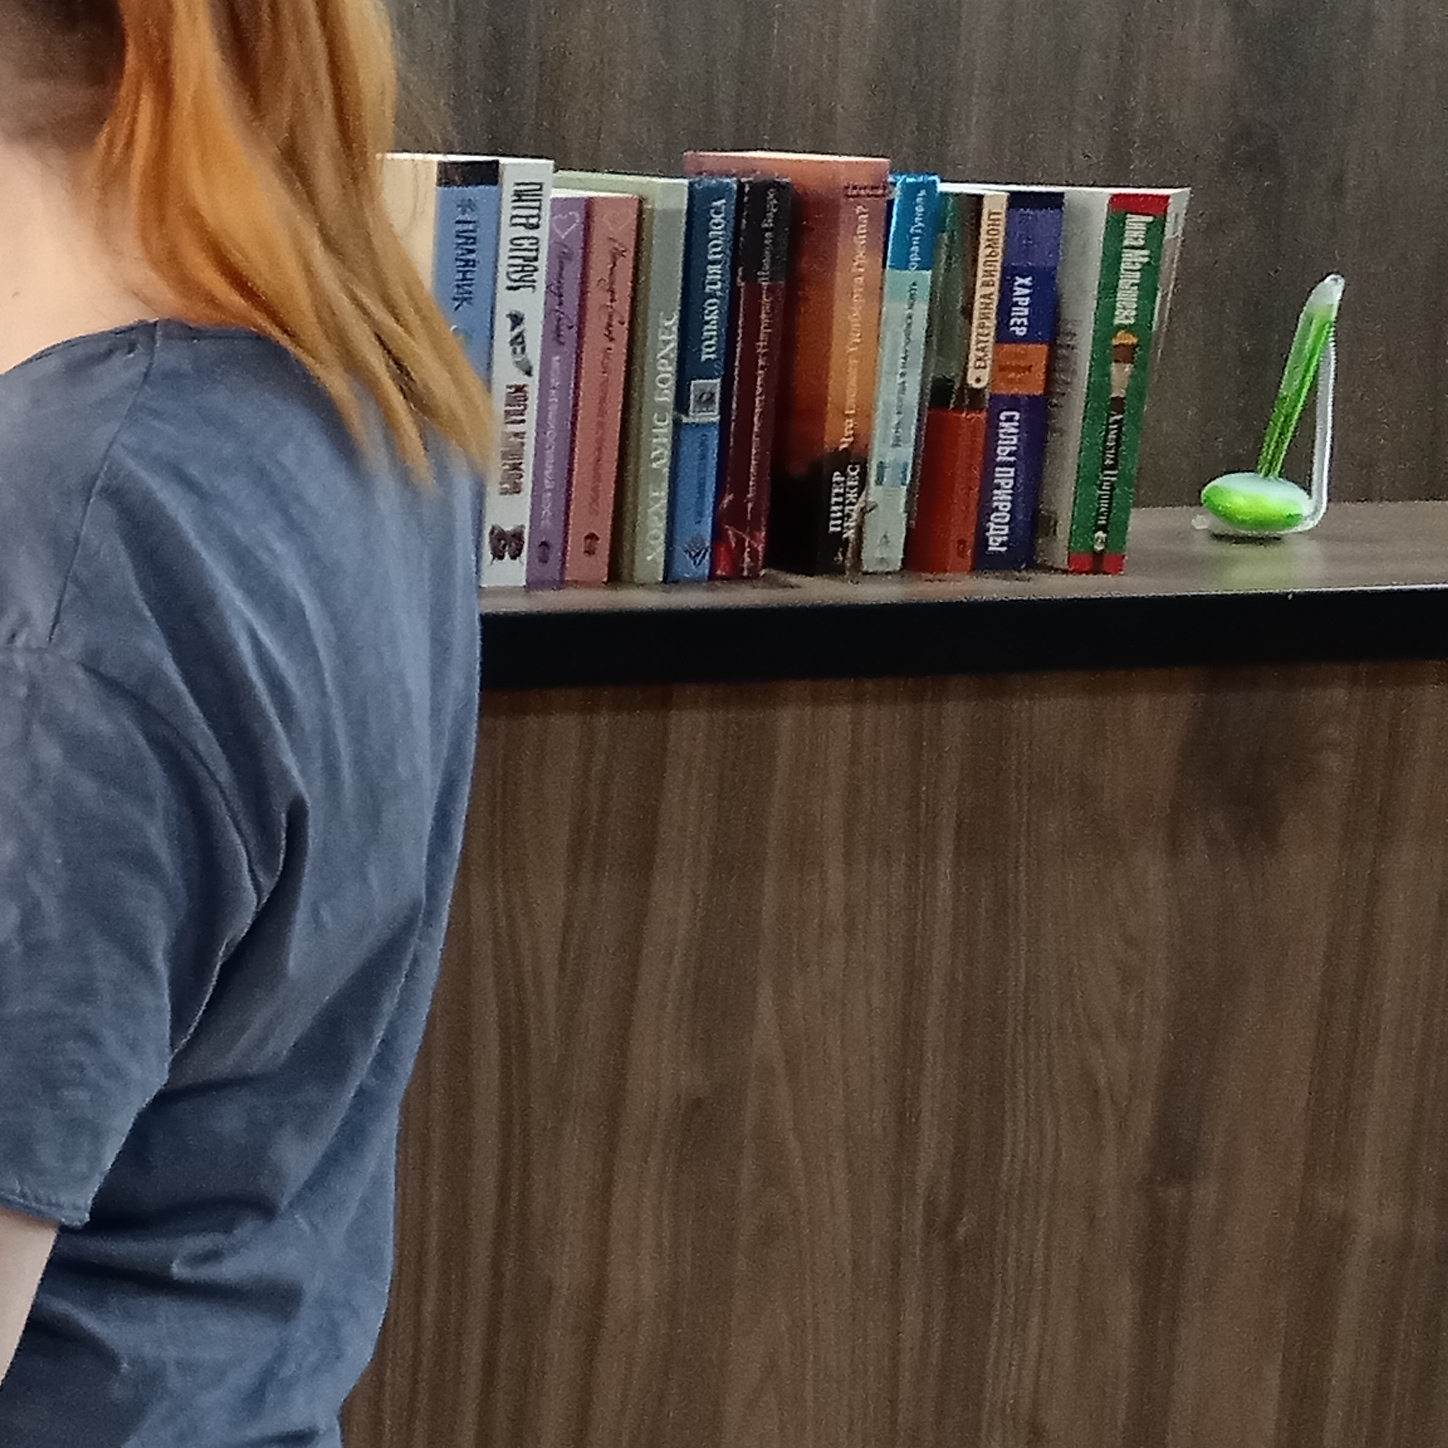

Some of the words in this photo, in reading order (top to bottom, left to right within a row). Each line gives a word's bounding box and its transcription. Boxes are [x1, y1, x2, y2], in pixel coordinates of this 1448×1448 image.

[509, 181, 544, 230] ПИТЕР
[706, 199, 729, 261] ГОЛОСА
[1125, 214, 1154, 246] Анна
[506, 235, 541, 291] СТРАУБ
[907, 237, 923, 272] оран
[979, 209, 1003, 288] ВИЛЬМОНТ
[1009, 276, 1034, 337] ХАРПЕР
[1115, 248, 1150, 325] Малышева
[654, 311, 678, 403] БОРХЕС
[700, 298, 721, 361] ТОЛЬКО
[974, 292, 997, 370] ЕКАТЕРИНА
[649, 413, 670, 472] ЛУИС
[995, 411, 1021, 461] СИЛЫ
[646, 482, 668, 562] ХОРХЕ
[828, 471, 846, 534] ПИТЕР
[987, 466, 1017, 553] ПРИРОДЫ
